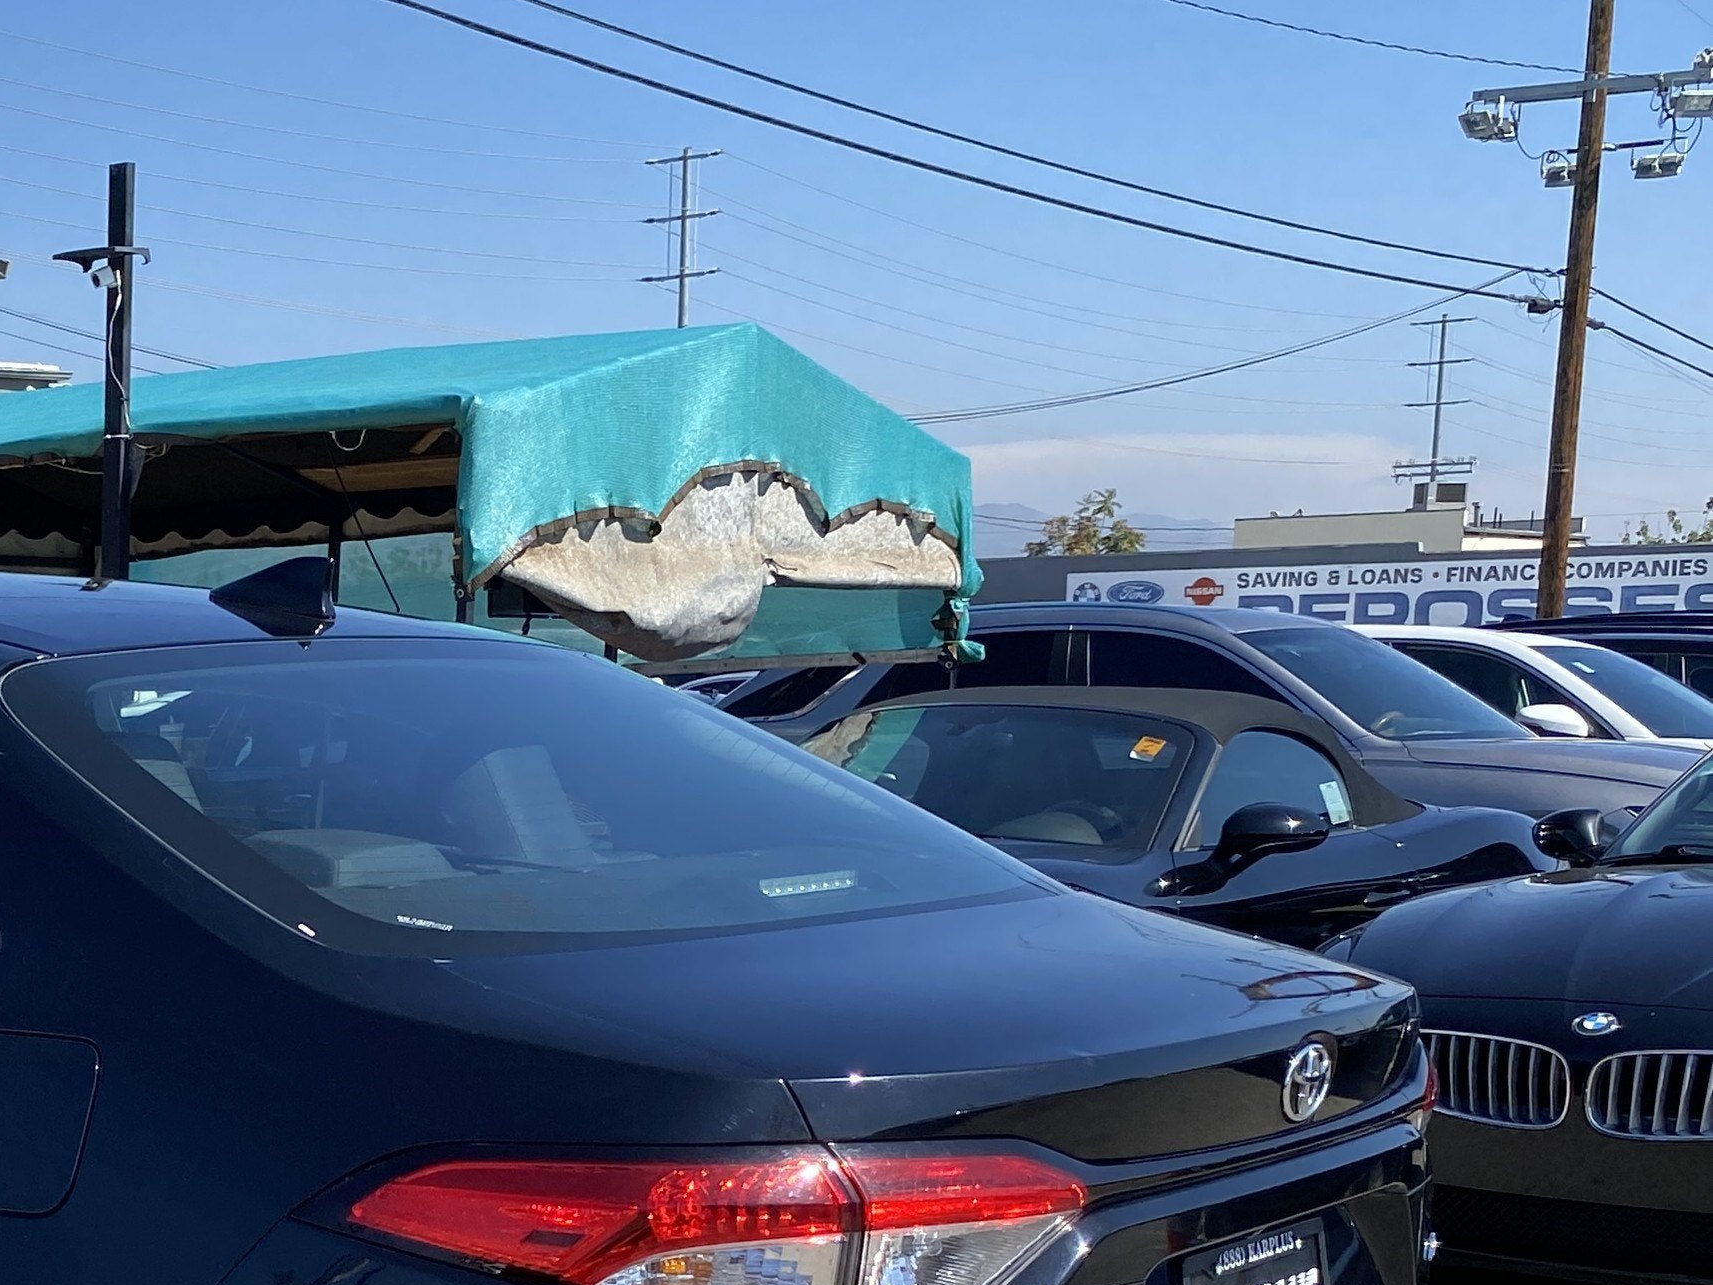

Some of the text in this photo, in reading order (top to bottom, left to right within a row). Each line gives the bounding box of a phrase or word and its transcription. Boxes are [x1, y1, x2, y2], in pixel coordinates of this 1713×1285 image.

[1236, 559, 1708, 588] SAVING & LOANS FINANC COMPANIES
[1119, 585, 1152, 601] Ford
[1186, 586, 1224, 597] NISSAN
[1248, 1230, 1295, 1263] KARPLUS
